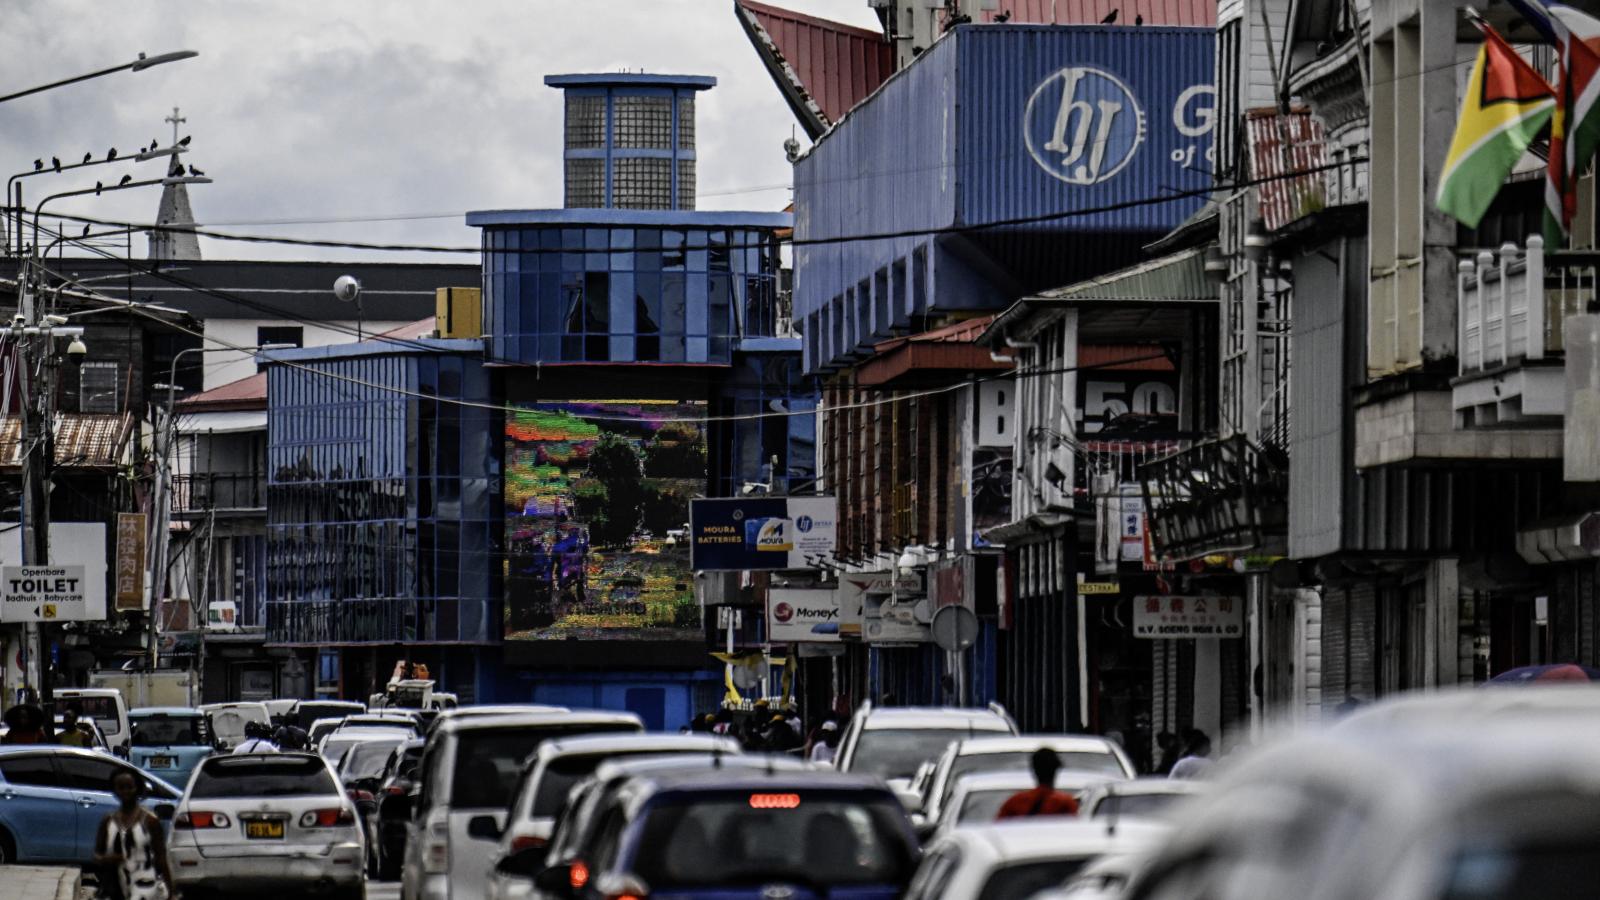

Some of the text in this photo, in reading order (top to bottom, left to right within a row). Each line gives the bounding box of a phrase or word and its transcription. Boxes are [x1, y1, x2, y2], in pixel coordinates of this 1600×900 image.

[1171, 147, 1196, 168] of
[703, 526, 736, 534] MOURA
[697, 536, 742, 544] BATTERIES
[21, 568, 66, 577] Openbare
[9, 578, 79, 593] TOILET
[5, 594, 37, 602] Badhuis
[44, 594, 83, 602] Babycare
